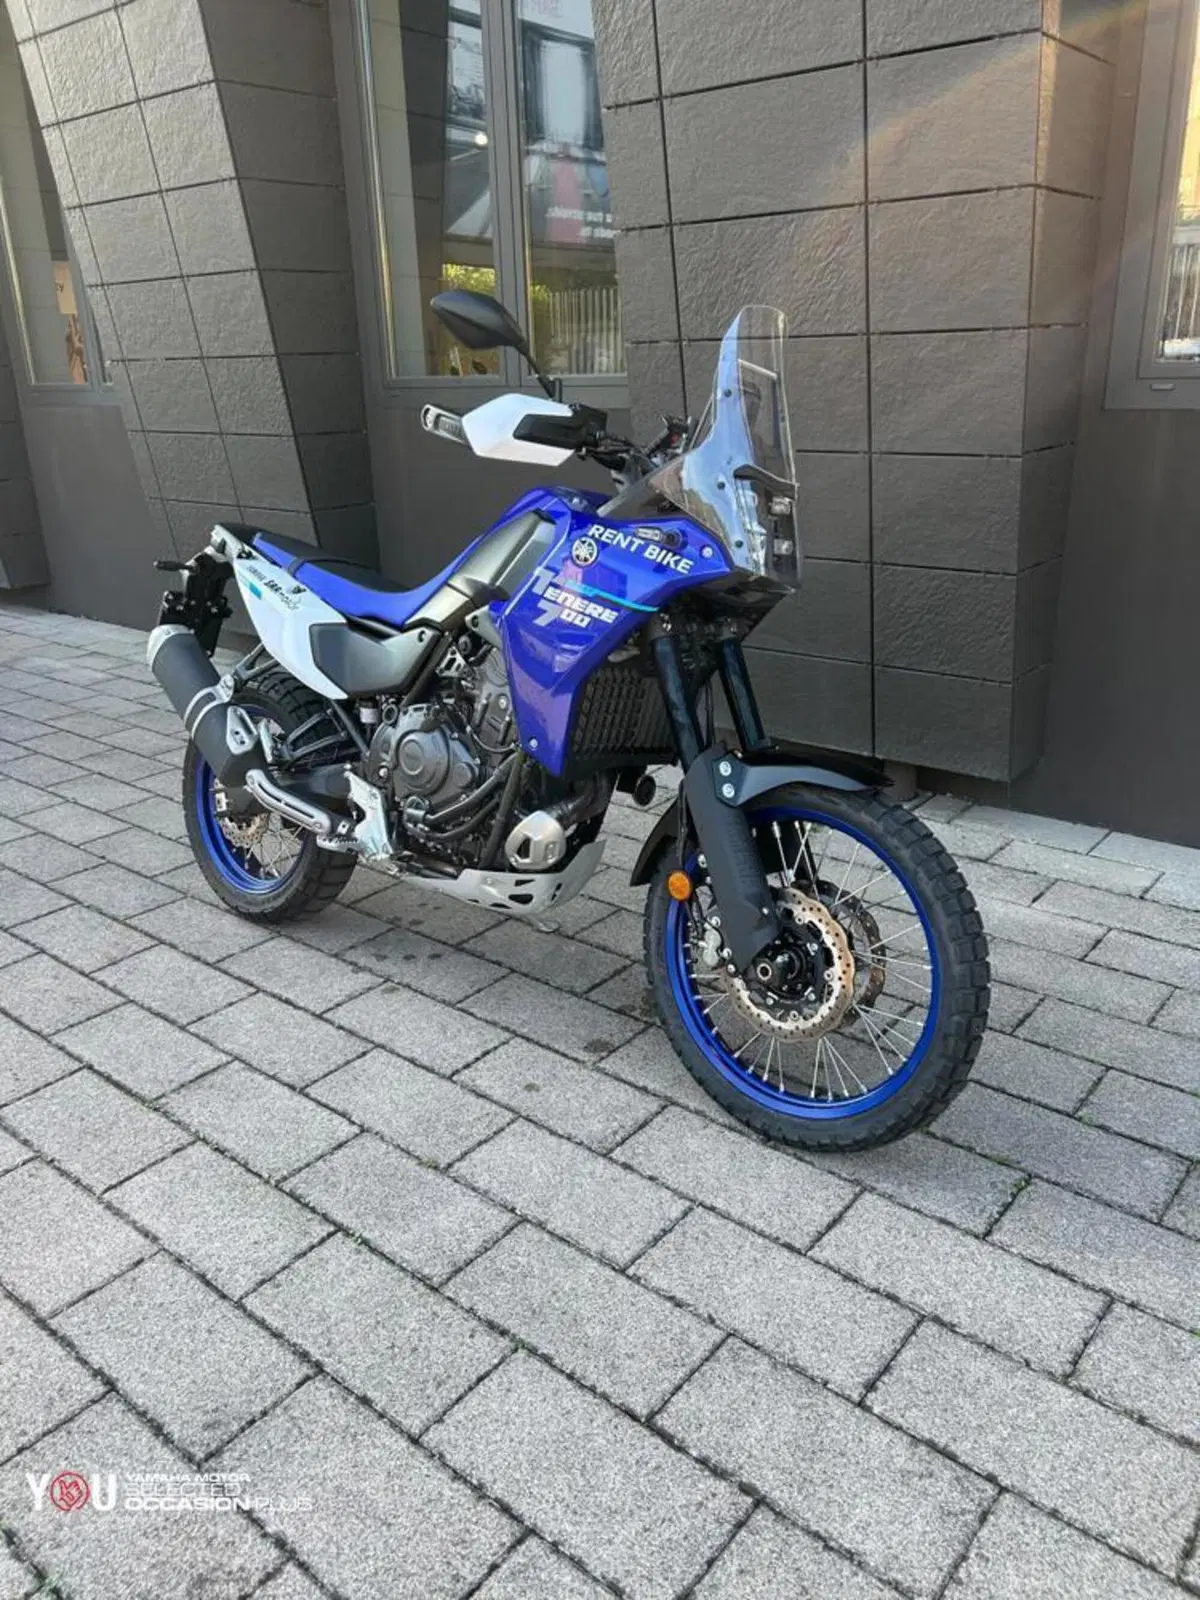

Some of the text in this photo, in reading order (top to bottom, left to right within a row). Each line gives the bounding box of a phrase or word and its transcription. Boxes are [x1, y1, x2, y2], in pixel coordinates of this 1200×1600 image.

[588, 524, 695, 574] RENT BIKE
[533, 599, 592, 628] 700
